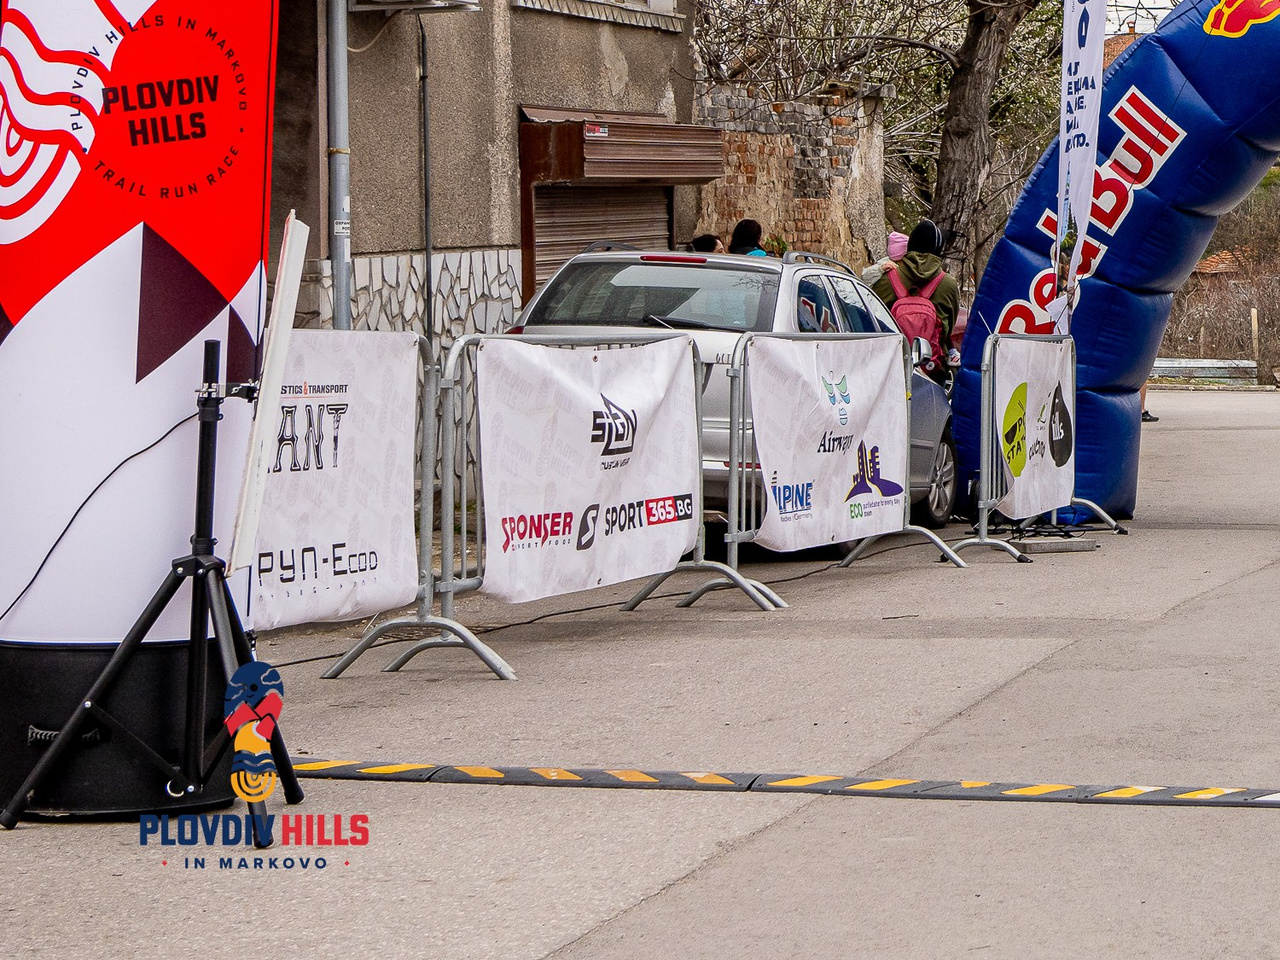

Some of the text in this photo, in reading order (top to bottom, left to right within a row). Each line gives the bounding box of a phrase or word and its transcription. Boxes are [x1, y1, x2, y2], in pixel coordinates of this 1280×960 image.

[69, 14, 248, 131] PLOVDIV HILLS IN MARKOVO
[101, 75, 219, 115] PLOVDIV
[128, 111, 207, 147] HILLS
[93, 145, 239, 199] TRAIL RUN RACE
[1090, 90, 1182, 231] Bull
[308, 384, 348, 394] TRANSPORT
[267, 404, 349, 474] ANT
[849, 503, 864, 520] ECO
[501, 512, 574, 554] SPONSER
